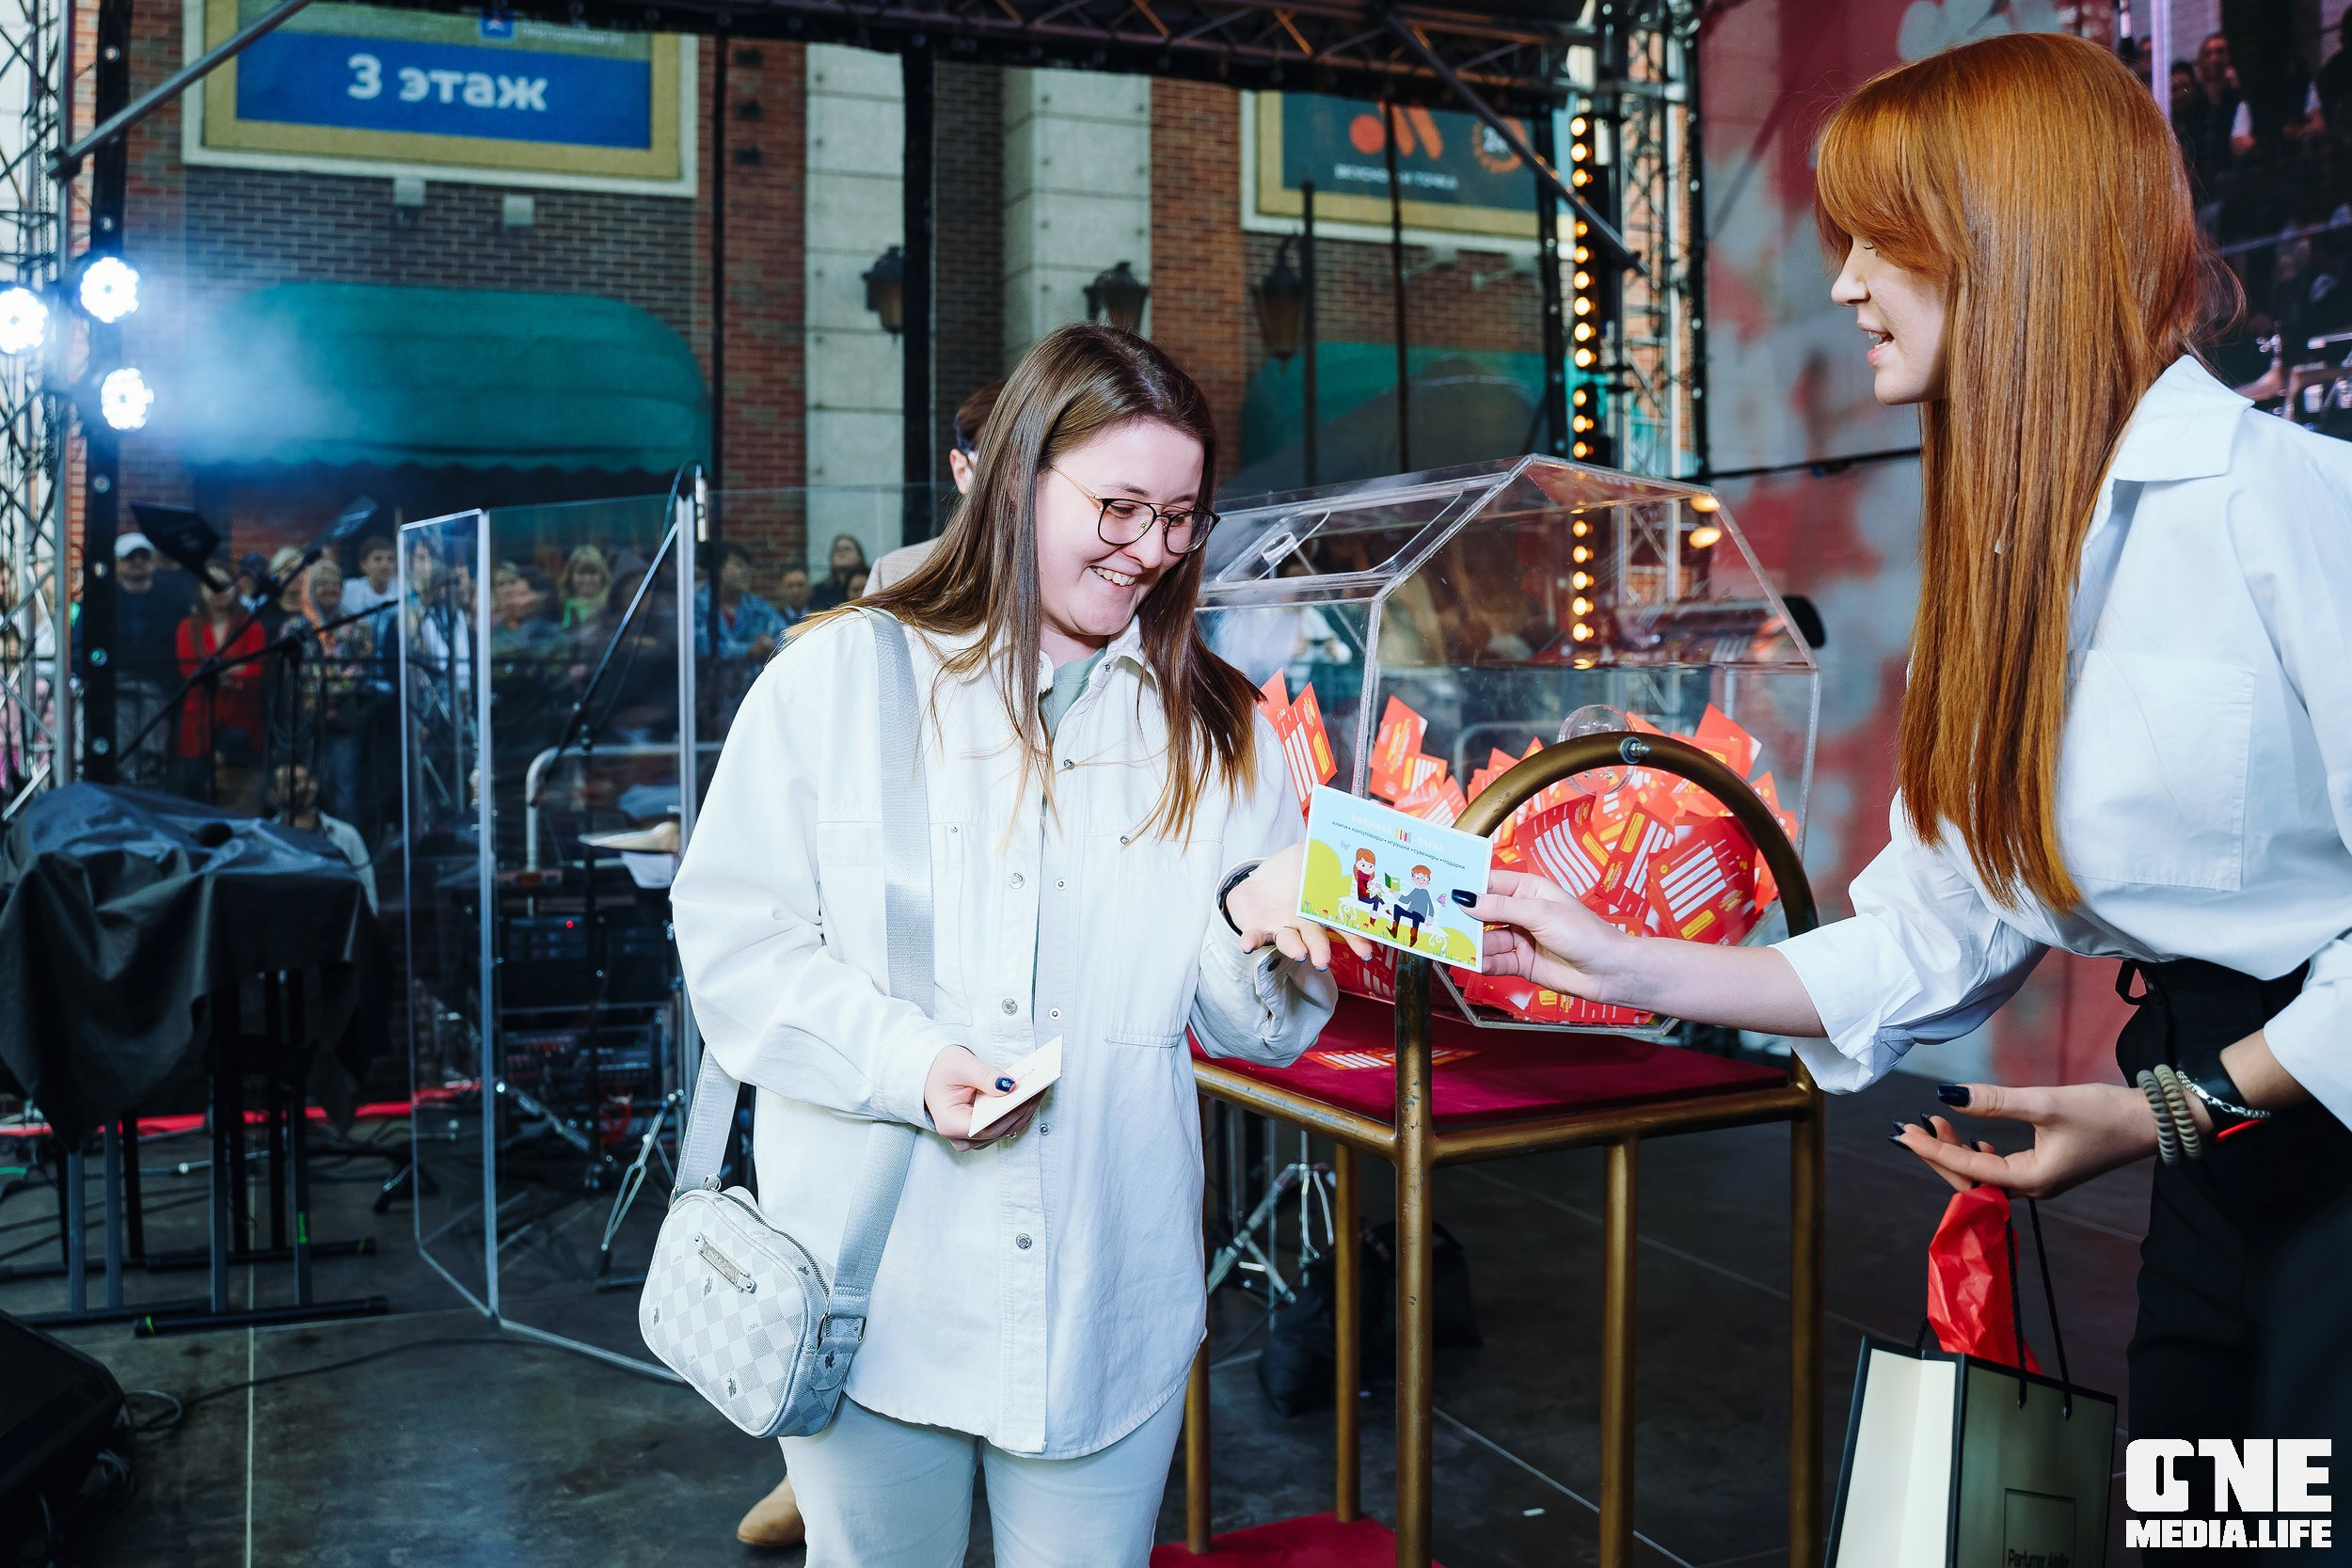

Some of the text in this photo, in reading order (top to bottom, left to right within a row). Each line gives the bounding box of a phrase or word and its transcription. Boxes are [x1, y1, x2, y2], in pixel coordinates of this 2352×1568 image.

[347, 53, 548, 112] 3 этаж
[1352, 828, 1384, 842] канцтовары
[1387, 840, 1410, 850] игрушки
[1413, 848, 1439, 861] сувениры
[1442, 859, 1466, 869] подарки
